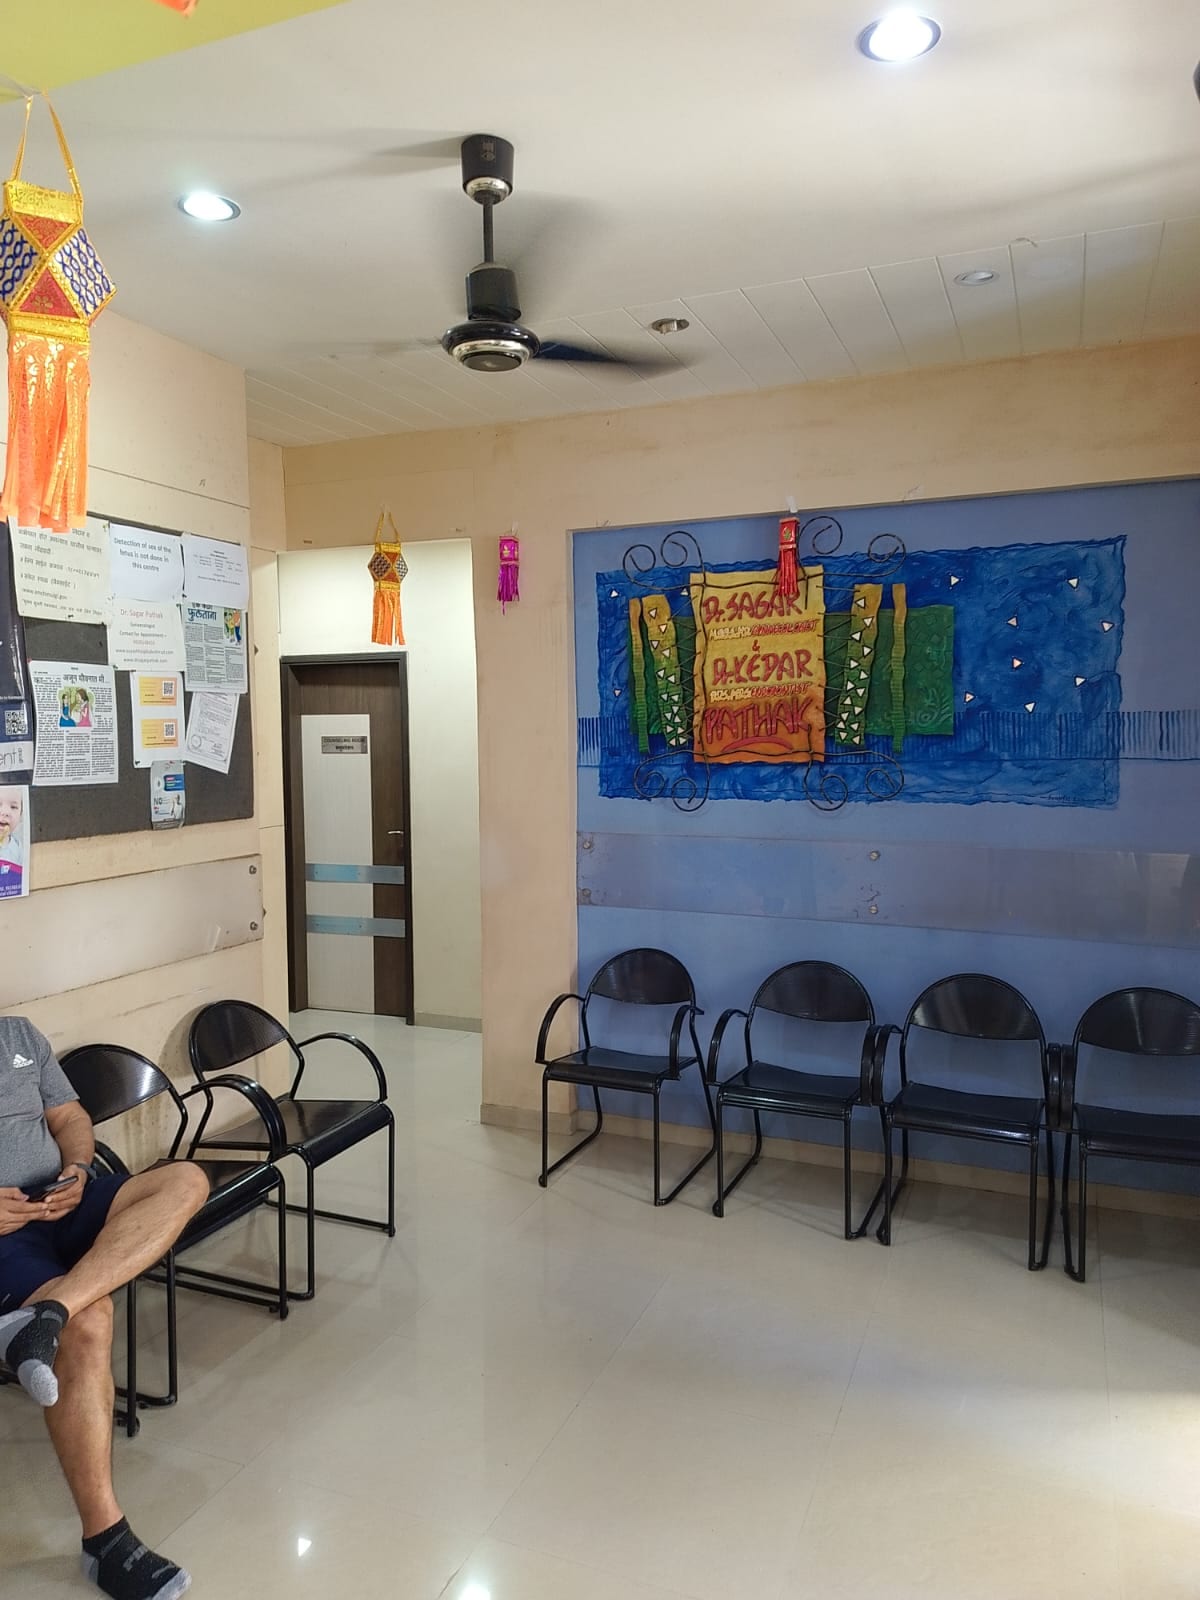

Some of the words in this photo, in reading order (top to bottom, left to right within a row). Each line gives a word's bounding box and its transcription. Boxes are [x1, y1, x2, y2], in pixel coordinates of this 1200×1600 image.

[114, 537, 141, 549] Detection
[150, 553, 163, 562] done
[120, 608, 129, 617] Dr.
[130, 609, 145, 619] Sagar
[752, 639, 760, 651] &
[704, 695, 813, 744] PATHAK
